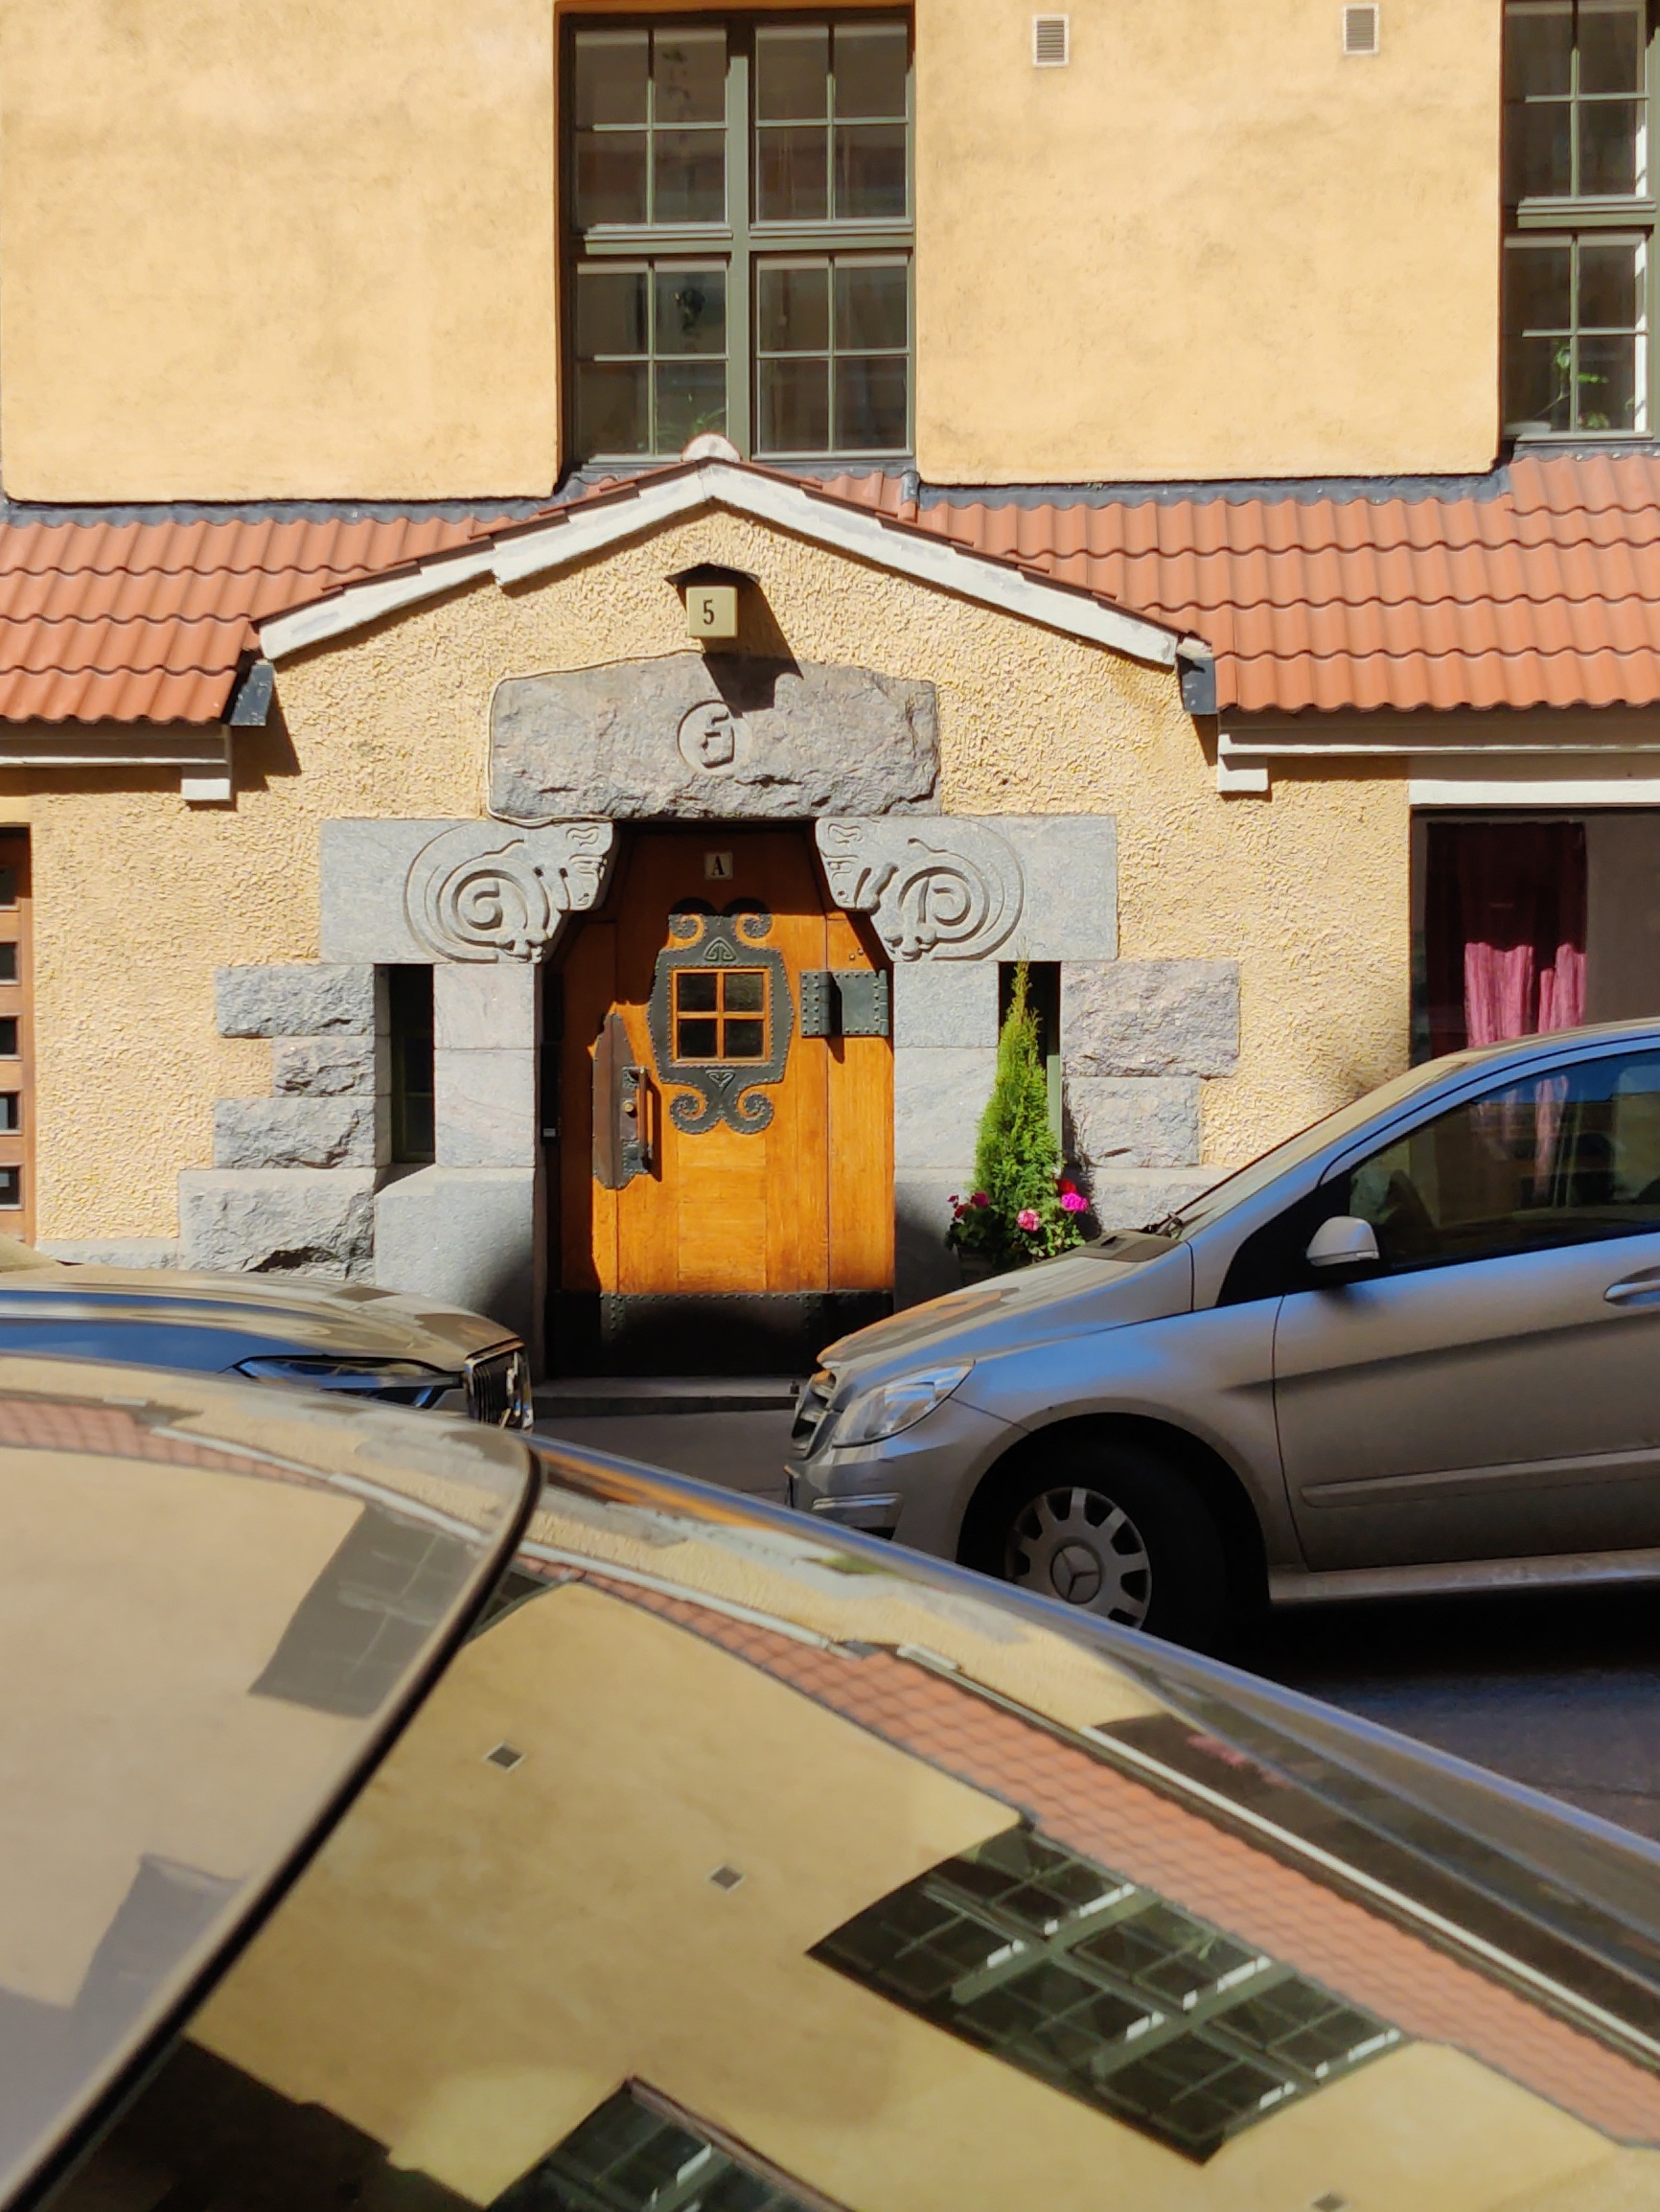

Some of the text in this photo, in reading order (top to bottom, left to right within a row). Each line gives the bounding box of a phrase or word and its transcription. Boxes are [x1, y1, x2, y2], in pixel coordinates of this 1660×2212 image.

[703, 599, 715, 625] 5
[700, 709, 735, 769] 5
[710, 855, 725, 876] A
